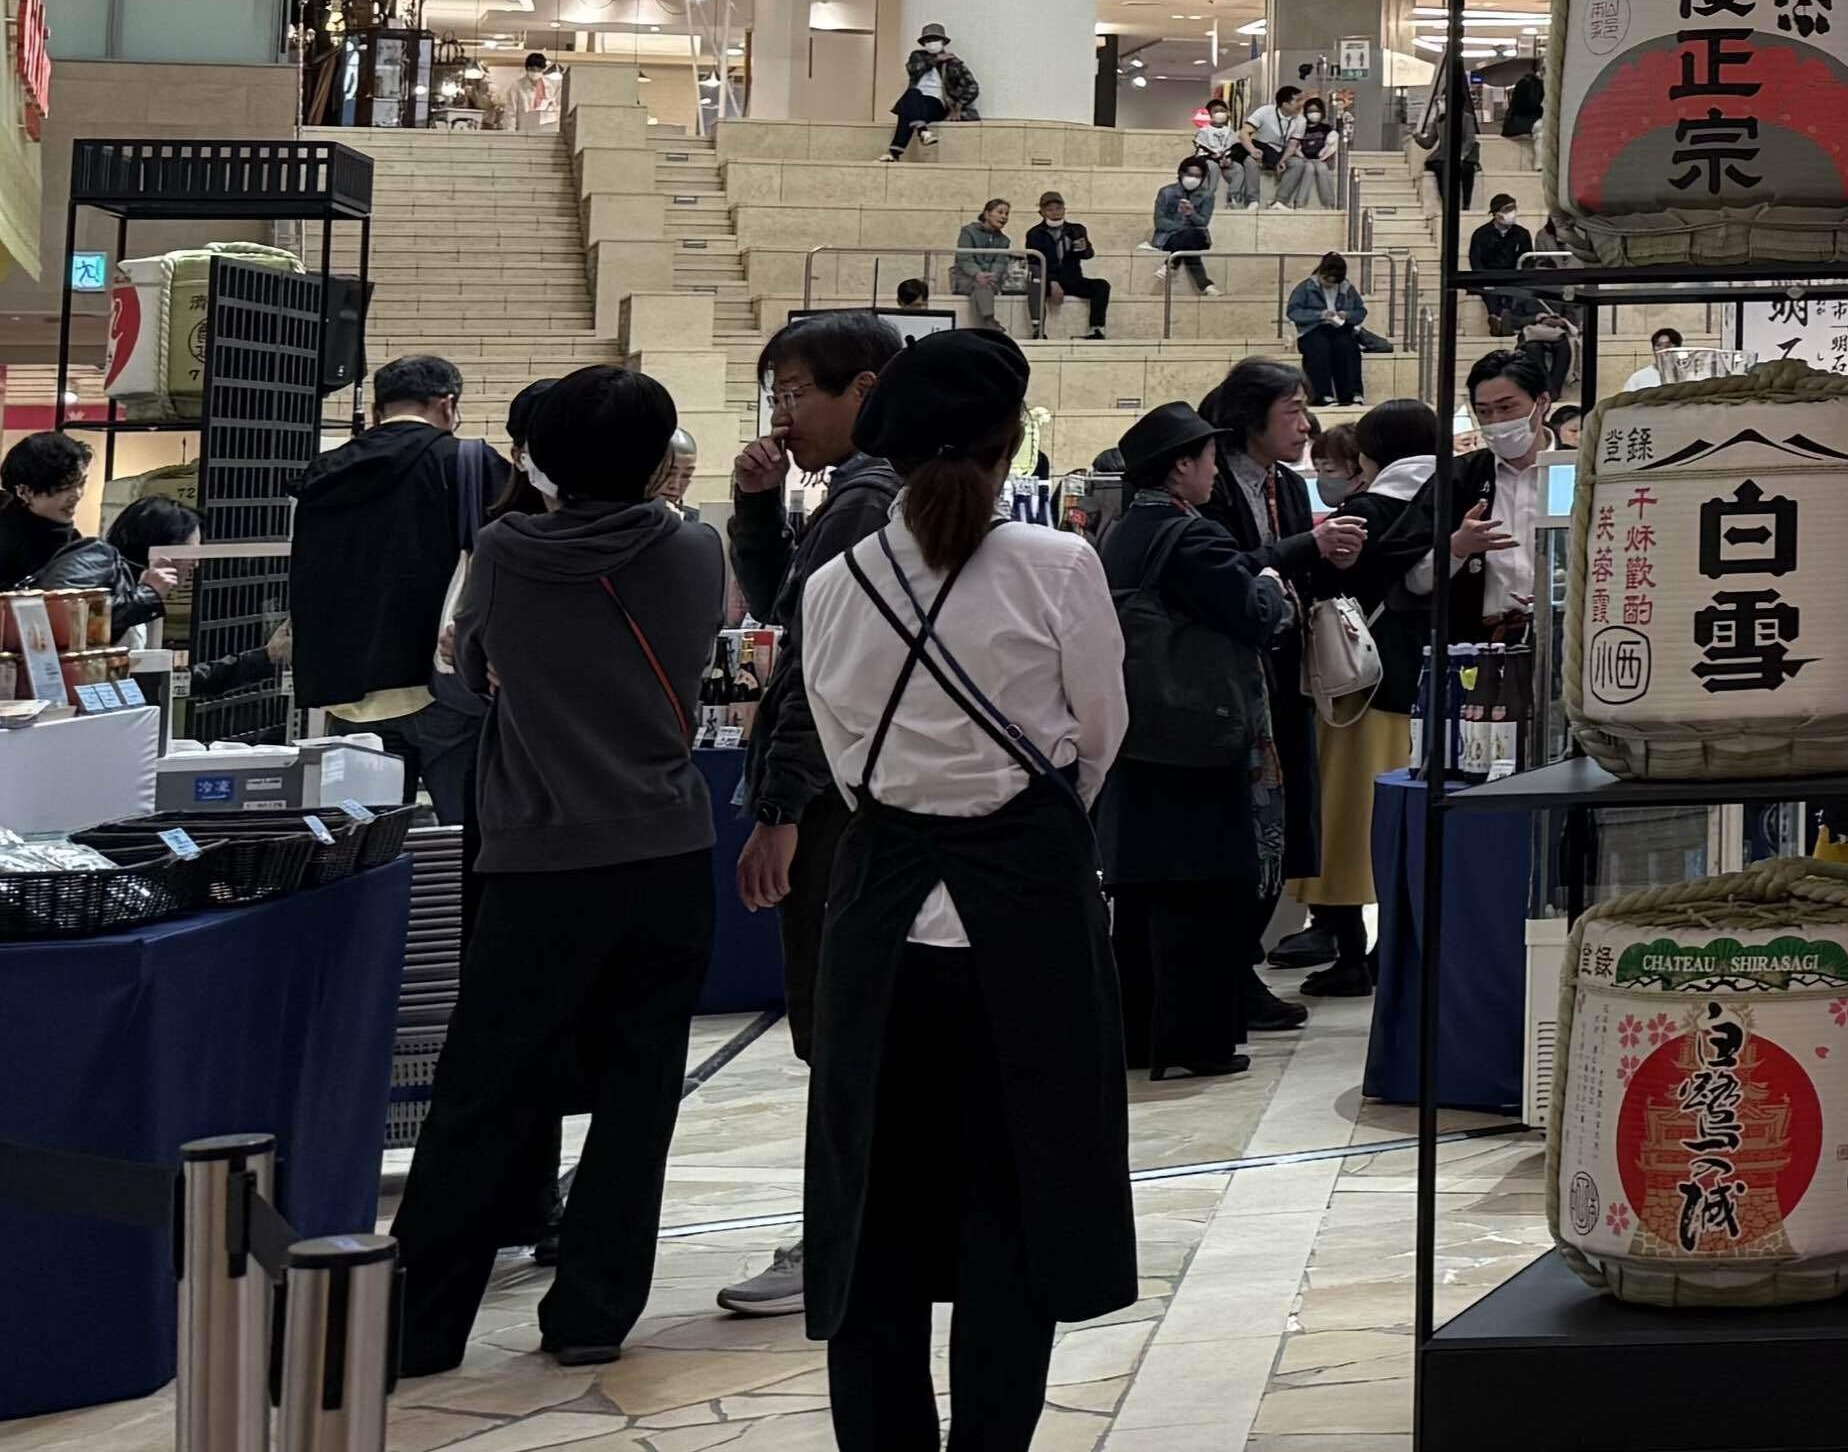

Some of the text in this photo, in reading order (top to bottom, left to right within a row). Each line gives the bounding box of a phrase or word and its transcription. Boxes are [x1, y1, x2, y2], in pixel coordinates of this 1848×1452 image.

[1691, 479, 1824, 693] 白雪
[1642, 955, 1819, 973] CHATEAU SHIRASAGI
